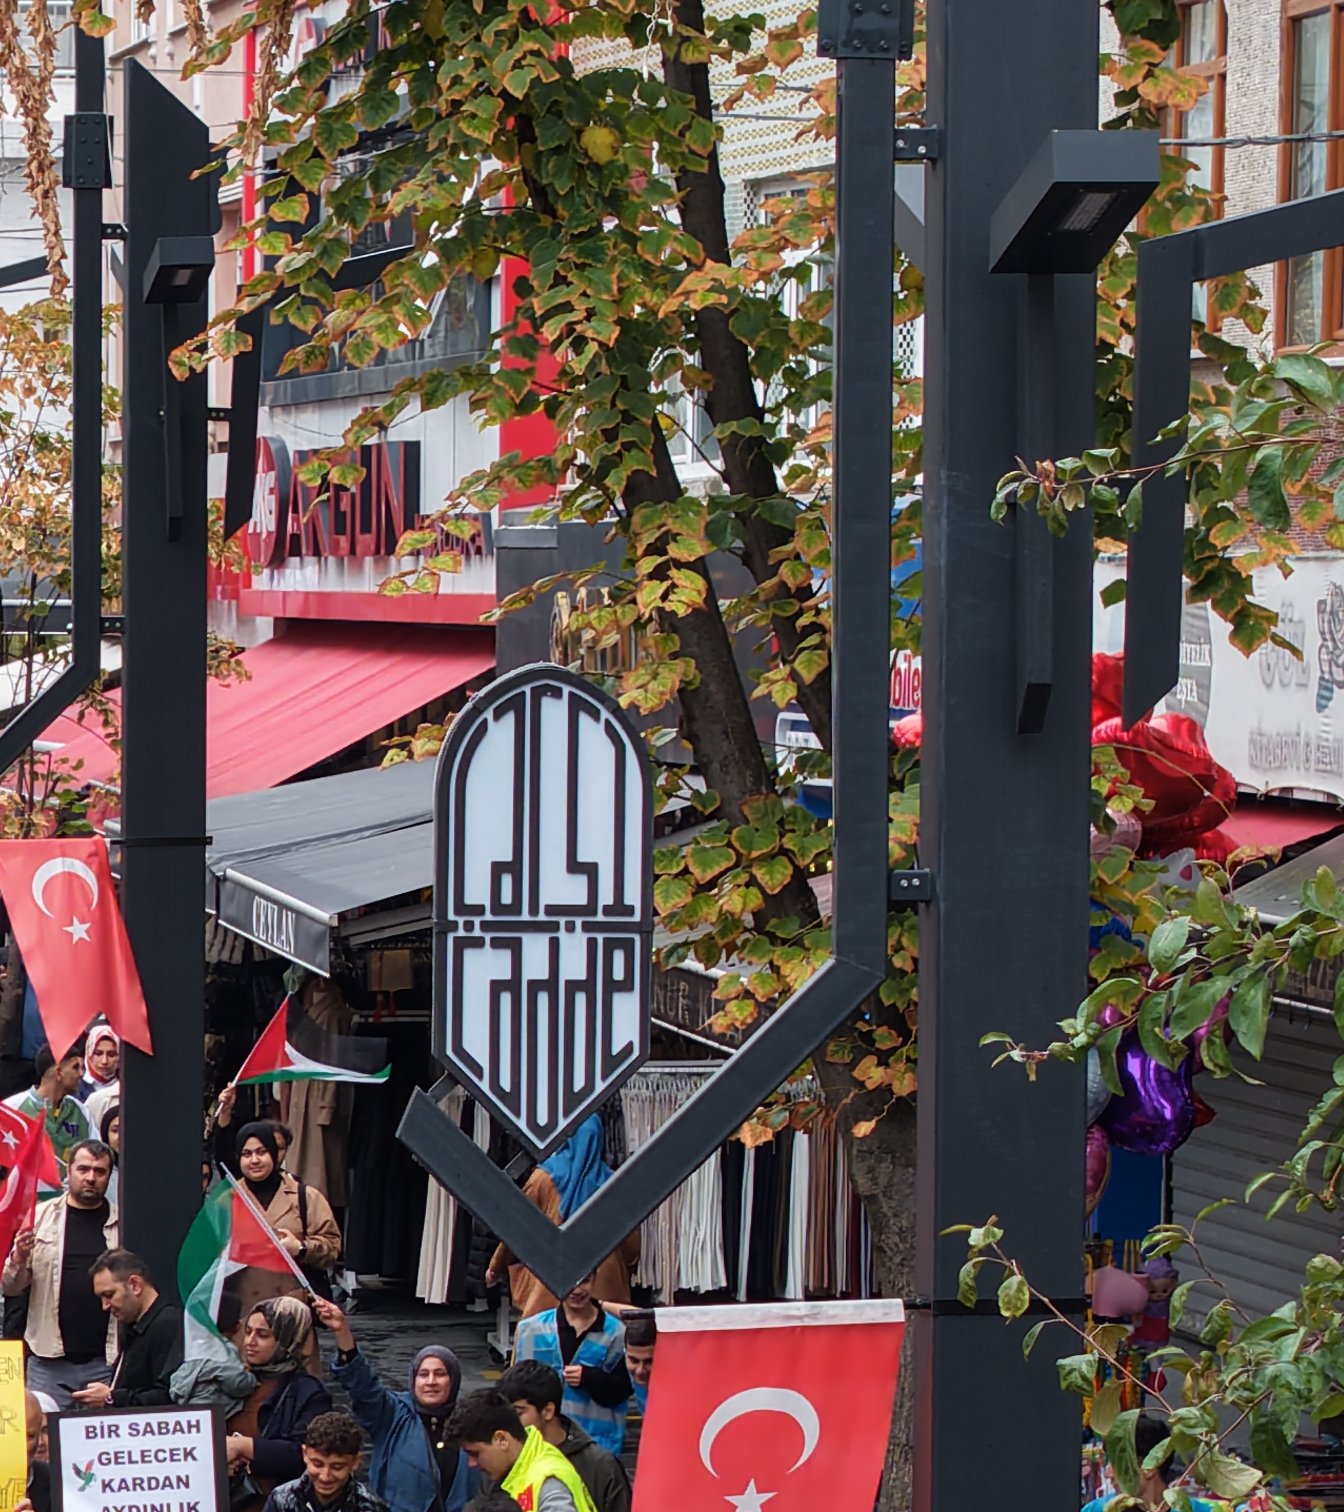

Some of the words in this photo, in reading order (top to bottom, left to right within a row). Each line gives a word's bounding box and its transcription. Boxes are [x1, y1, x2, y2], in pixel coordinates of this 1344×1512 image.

[85, 1421, 121, 1440] BİR
[127, 1419, 201, 1437] SABAH
[97, 1446, 198, 1467] GELECEK
[101, 1474, 190, 1494] KARDAN
